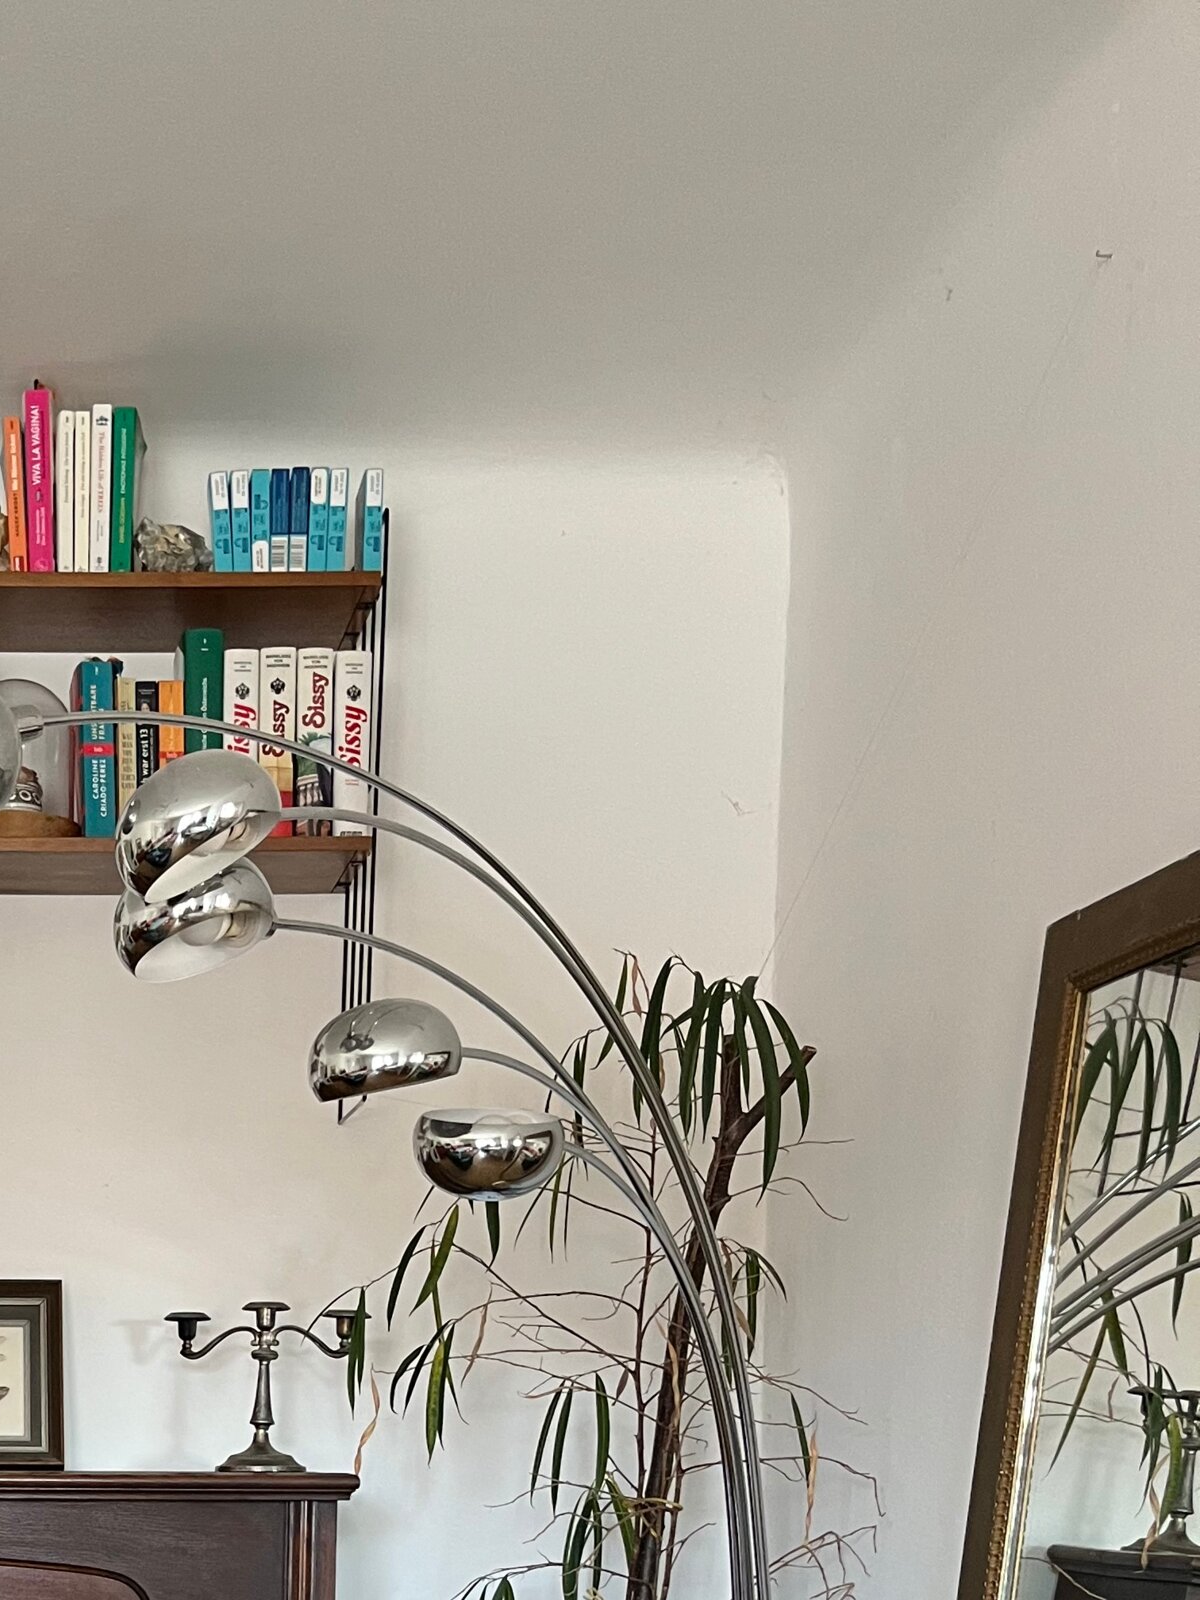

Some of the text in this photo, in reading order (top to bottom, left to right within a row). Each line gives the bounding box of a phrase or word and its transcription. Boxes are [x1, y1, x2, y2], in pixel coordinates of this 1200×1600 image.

[30, 405, 42, 485] VIVA LA VAGINA!
[302, 672, 330, 728] Sissy
[140, 728, 148, 738] 13
[140, 740, 148, 757] erst
[227, 703, 256, 754] issy
[261, 700, 290, 757] Sssy
[141, 759, 149, 775] war
